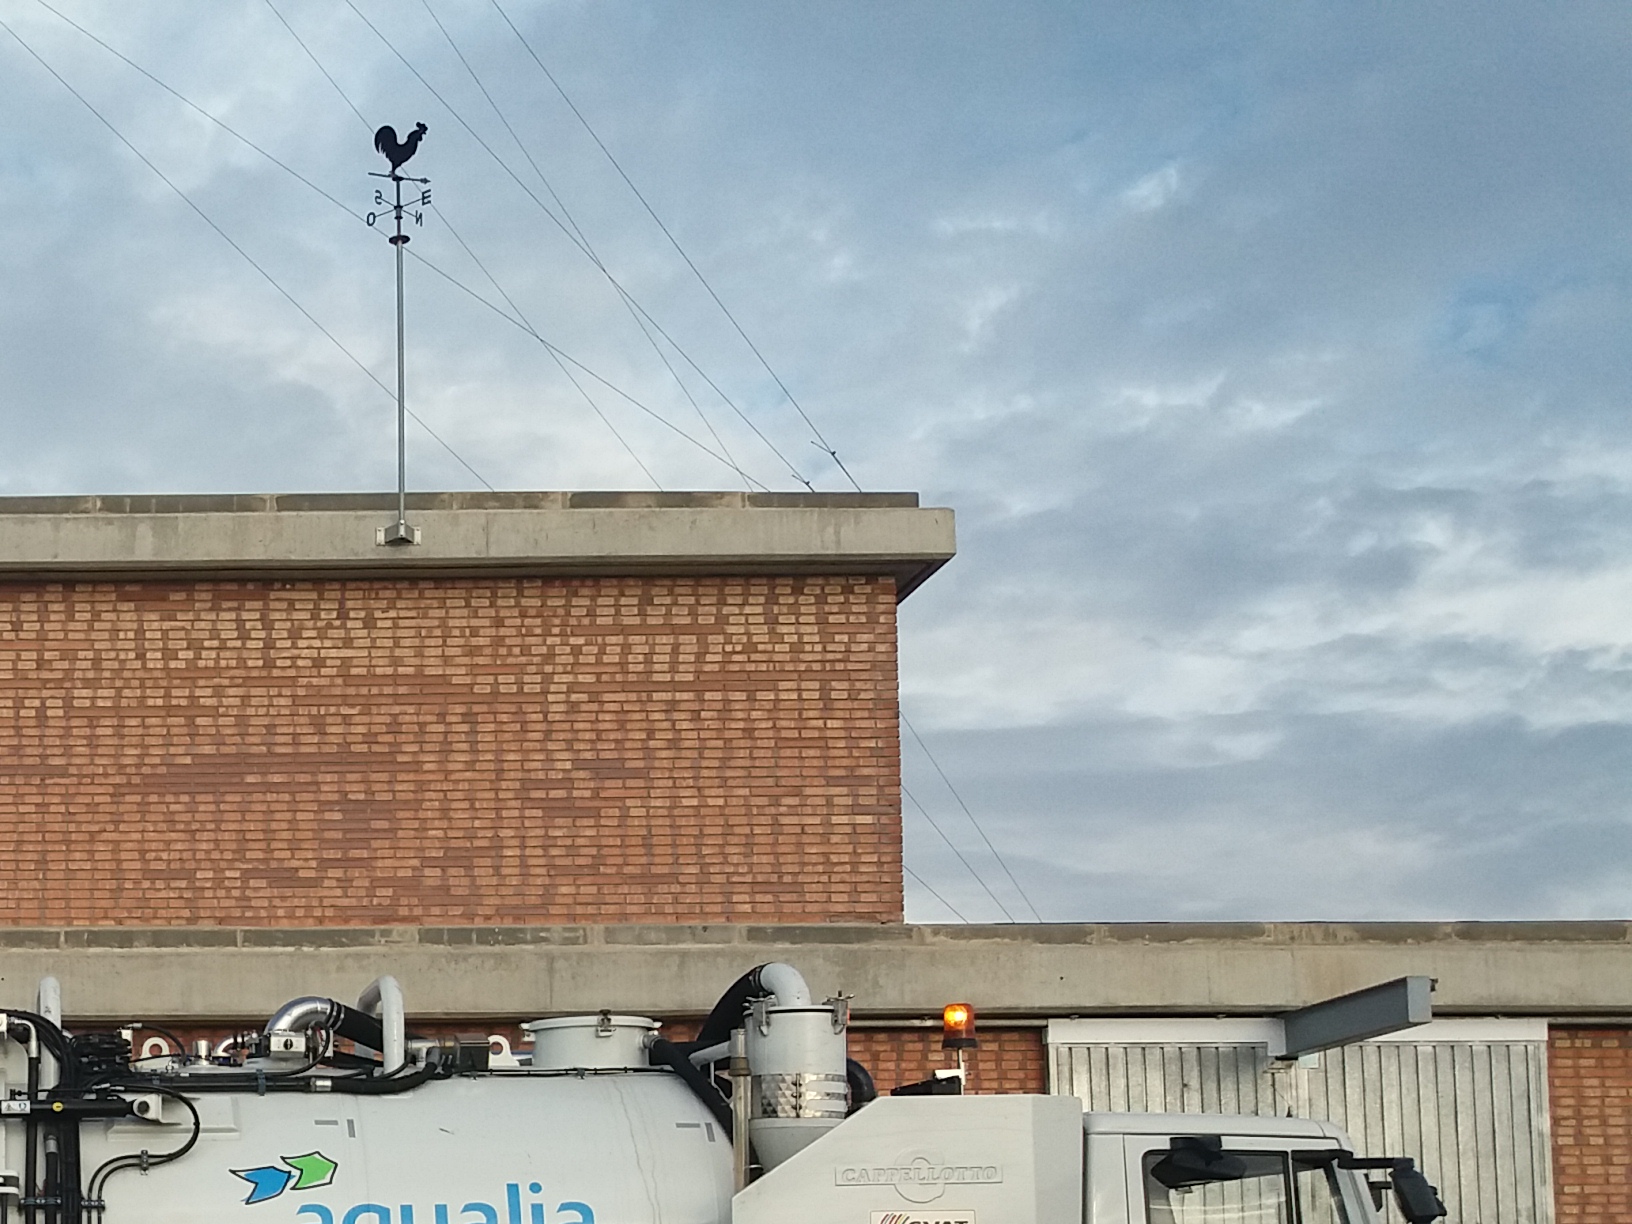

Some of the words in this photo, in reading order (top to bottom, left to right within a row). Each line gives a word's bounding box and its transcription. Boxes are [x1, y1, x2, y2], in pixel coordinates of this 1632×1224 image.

[422, 189, 432, 206] E
[366, 212, 376, 227] O
[841, 1166, 997, 1183] CAPPELLOTTO
